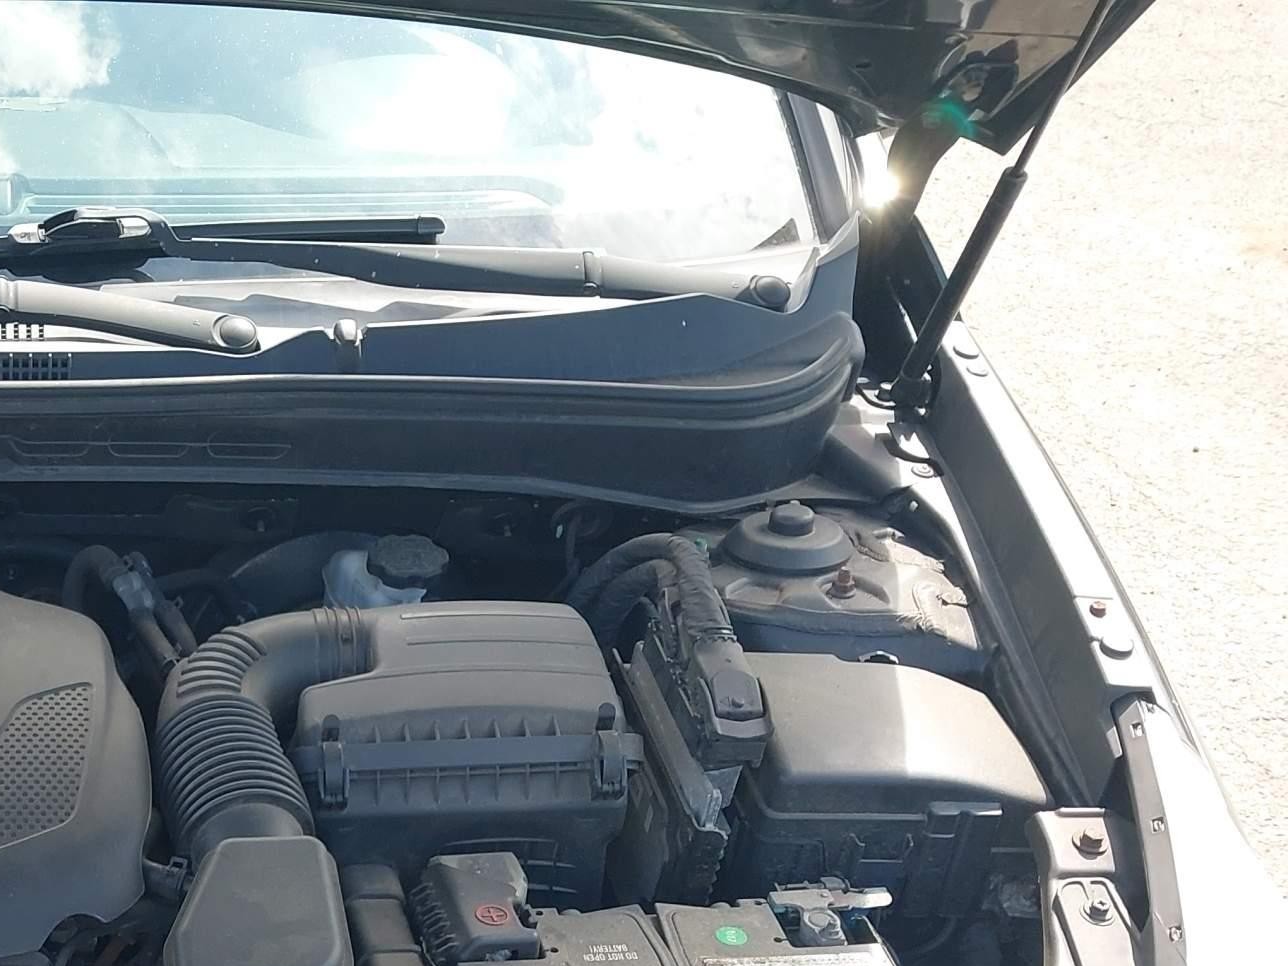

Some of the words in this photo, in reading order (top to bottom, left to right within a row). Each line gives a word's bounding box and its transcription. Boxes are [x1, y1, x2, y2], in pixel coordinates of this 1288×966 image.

[583, 953, 606, 962] OPEN
[607, 952, 624, 961] NOT
[625, 951, 639, 960] DO
